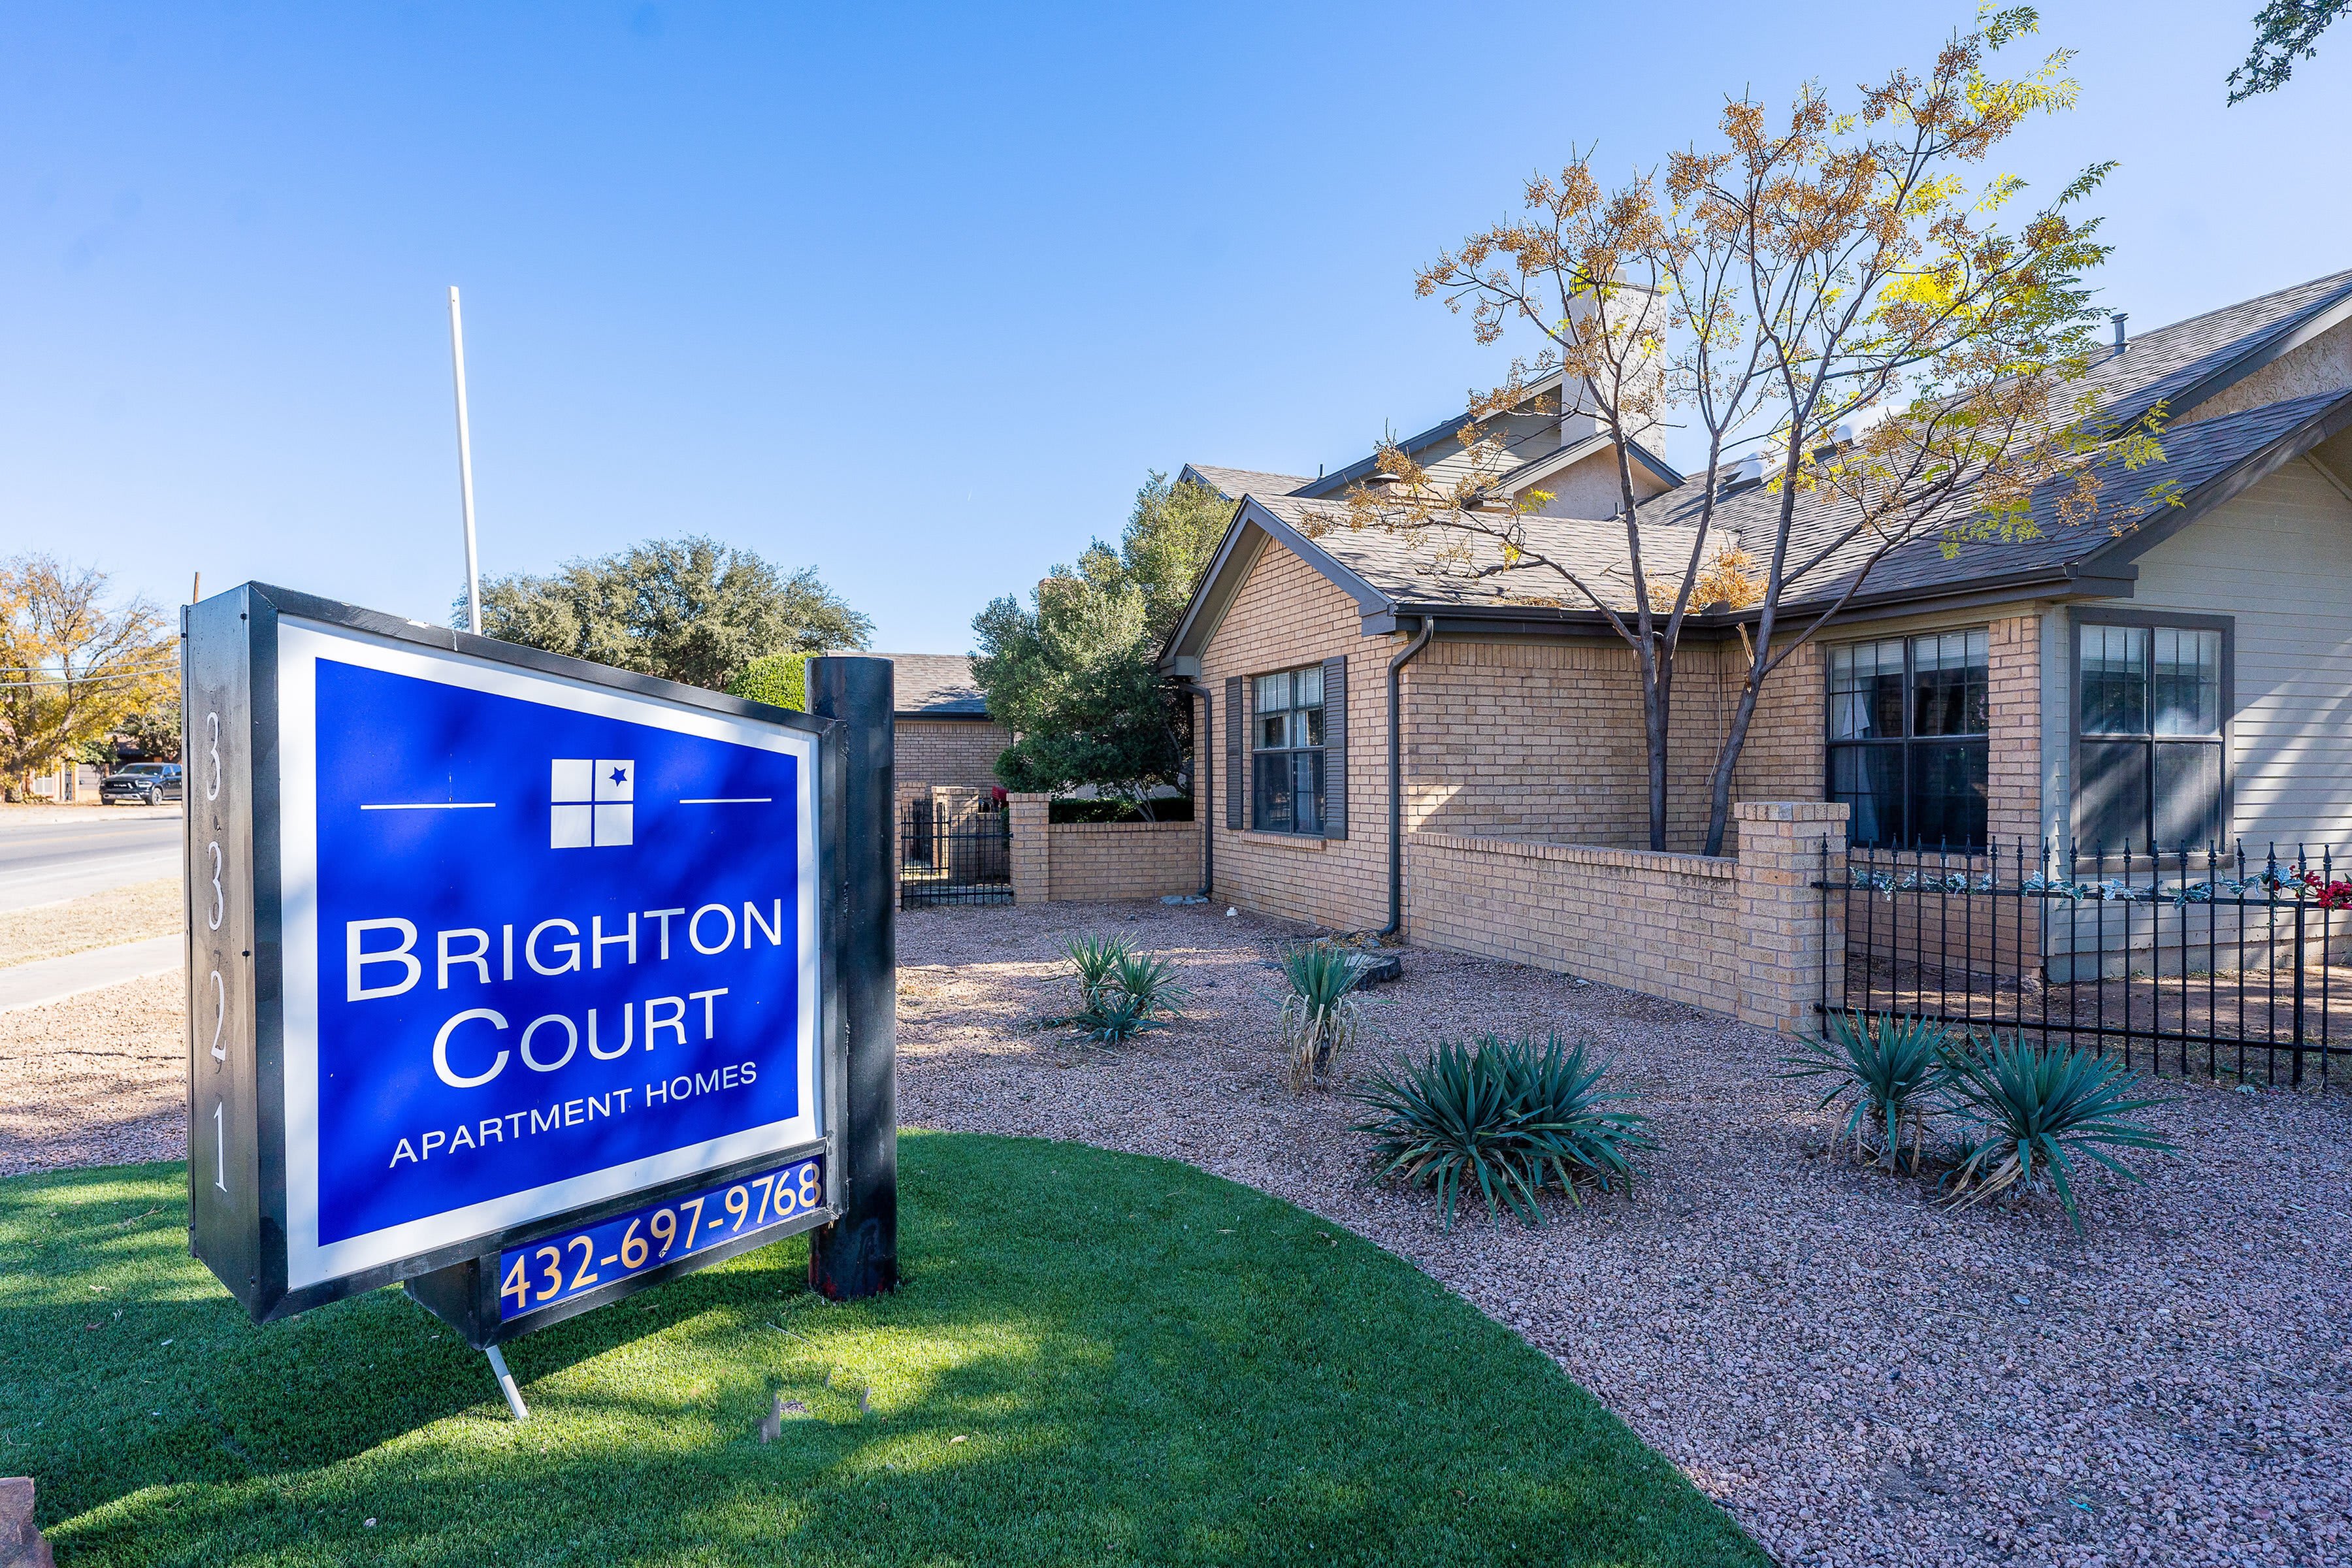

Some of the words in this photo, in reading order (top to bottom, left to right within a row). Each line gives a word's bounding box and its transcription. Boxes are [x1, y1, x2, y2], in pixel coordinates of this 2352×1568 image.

[206, 711, 227, 1193] 3321
[346, 898, 782, 1002] BRIGHTON
[433, 987, 728, 1088] COURT
[390, 1088, 632, 1168] APARTMENT
[645, 1061, 757, 1107] HOMES
[500, 1163, 821, 1309] 432-697-9768
